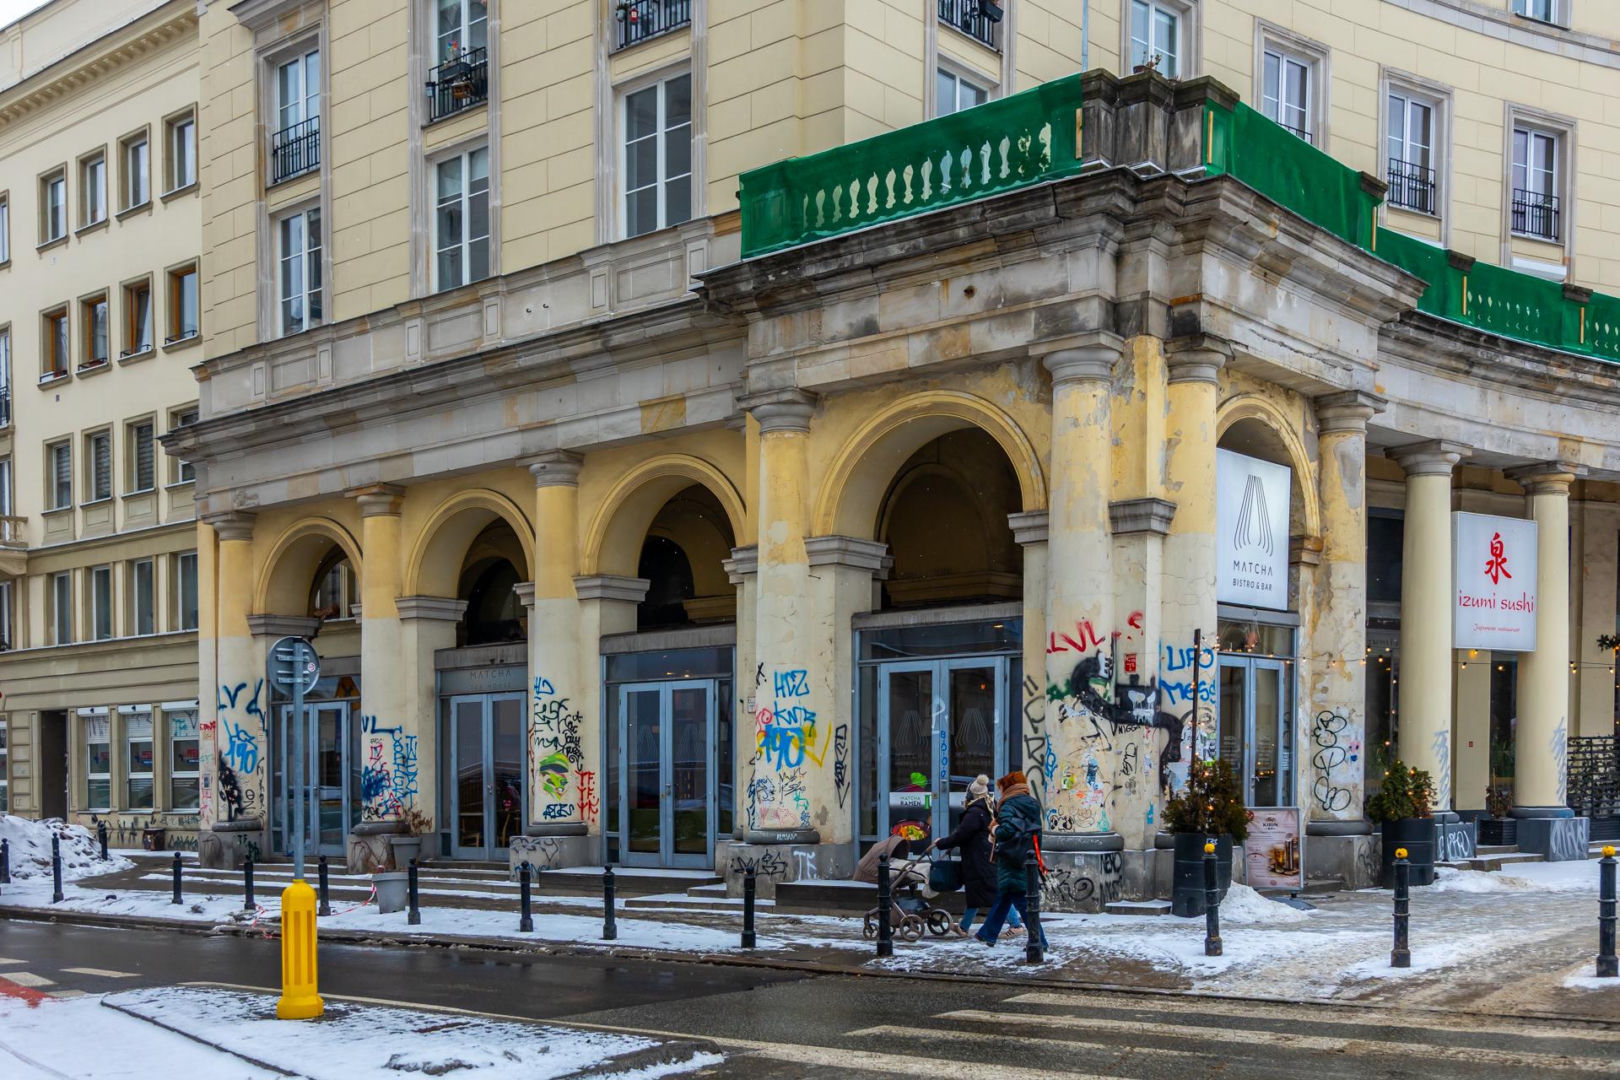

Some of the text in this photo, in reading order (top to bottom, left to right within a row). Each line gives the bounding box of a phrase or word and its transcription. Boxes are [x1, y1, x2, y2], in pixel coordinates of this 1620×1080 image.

[1484, 532, 1512, 585] 泉
[1233, 560, 1273, 576] MATCHA
[1233, 578, 1272, 591] BISTRO & BAR
[1459, 590, 1534, 613] izumi sushi
[470, 669, 512, 680] MATCHA
